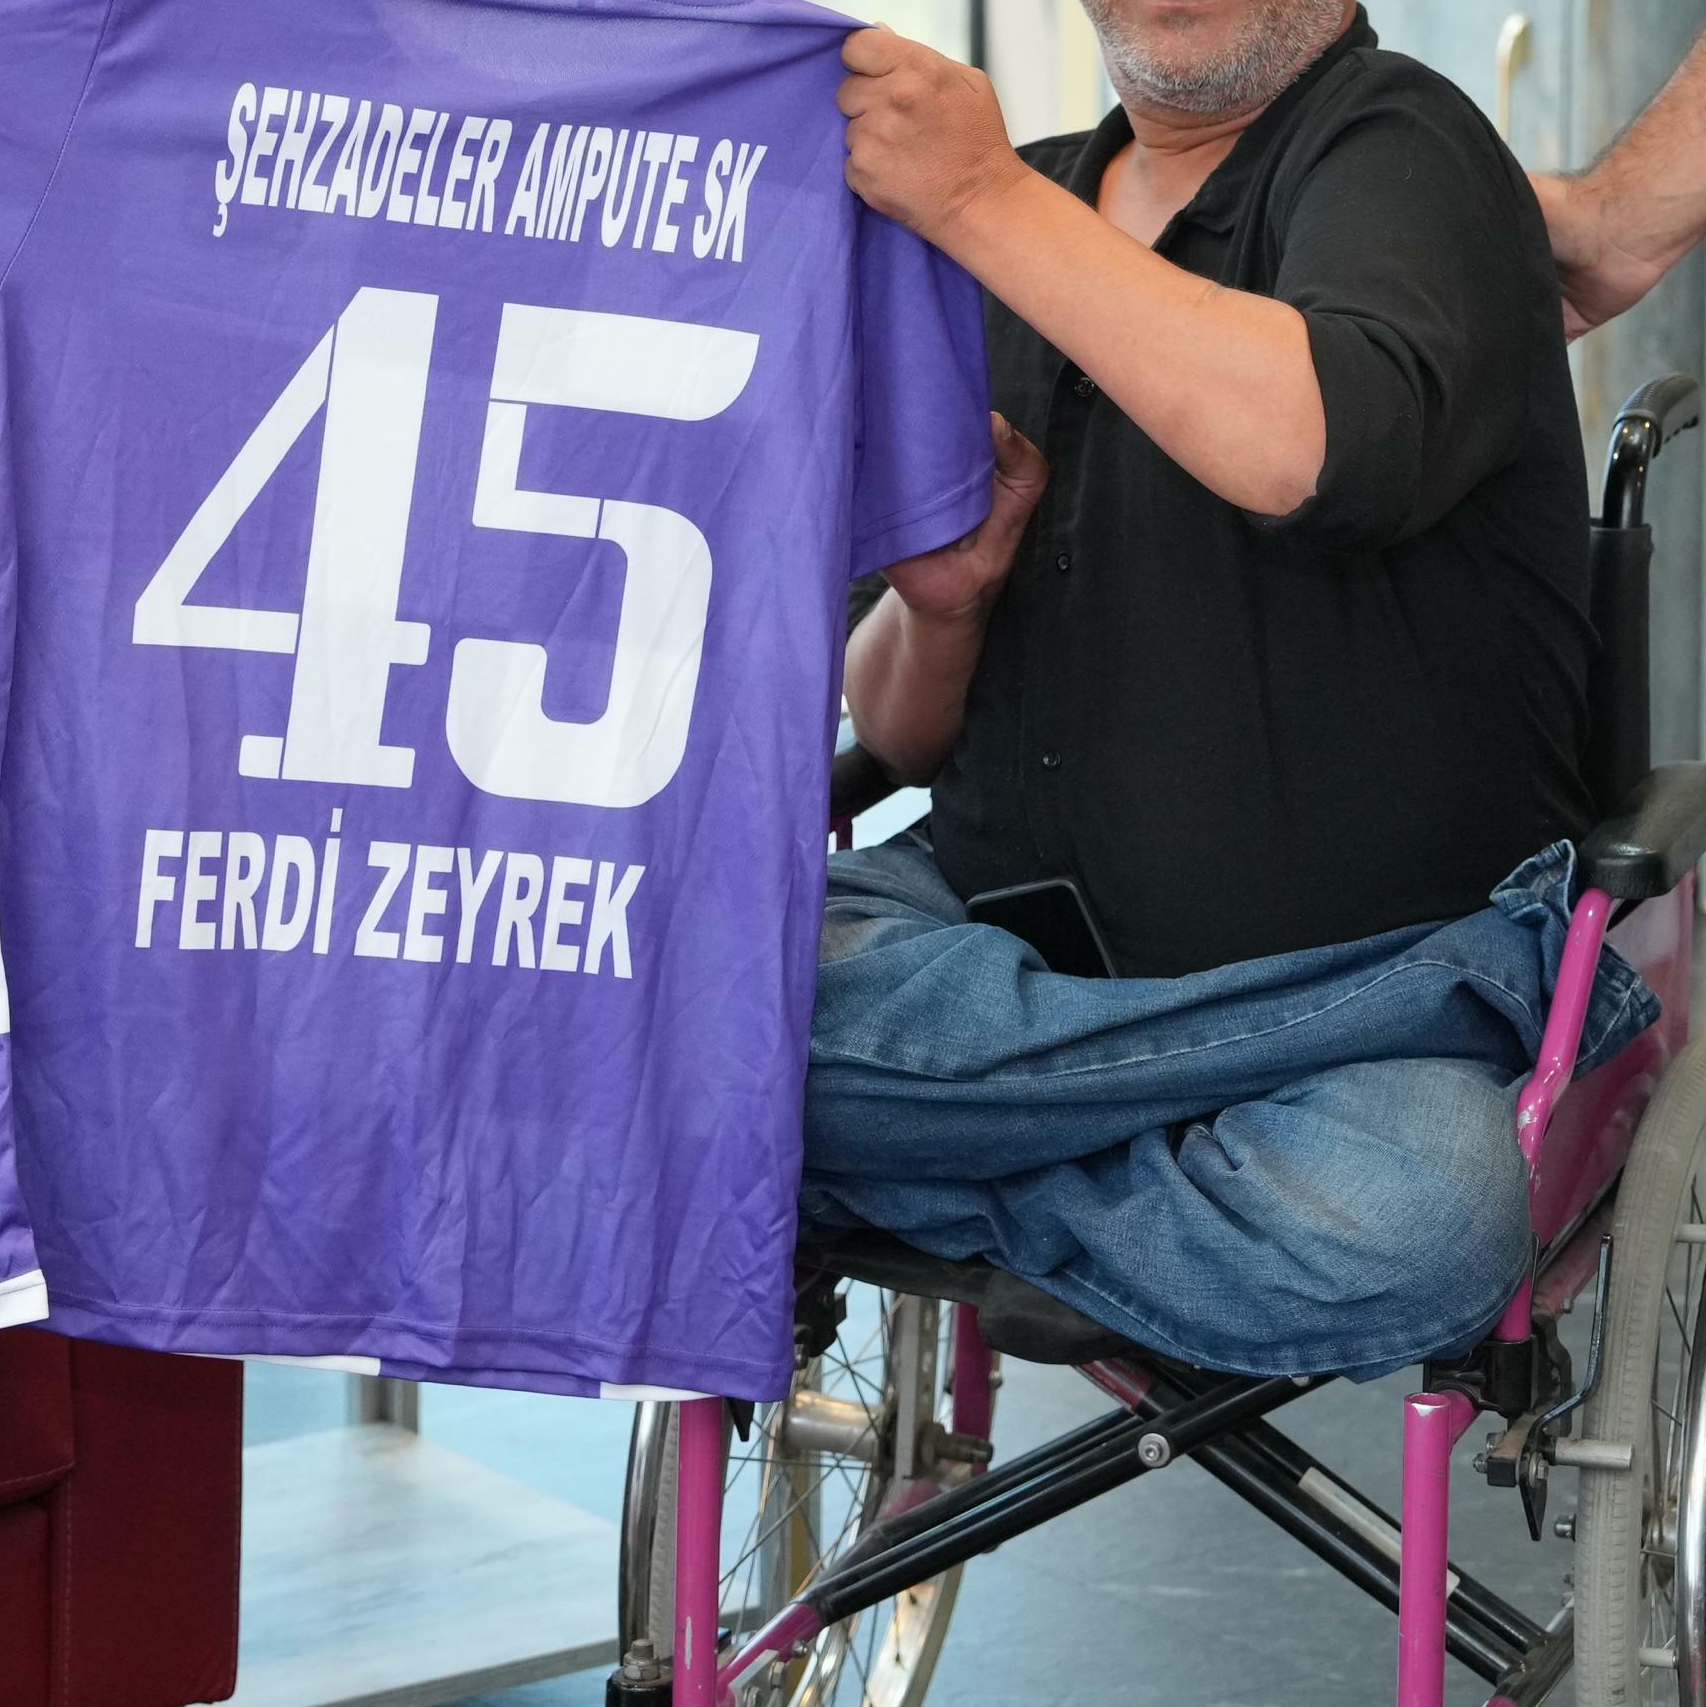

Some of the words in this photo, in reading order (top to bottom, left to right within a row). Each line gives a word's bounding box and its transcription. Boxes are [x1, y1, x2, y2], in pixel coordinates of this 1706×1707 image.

[212, 82, 513, 238] ŞEHZADELER
[503, 123, 699, 254] AMPUTE
[692, 138, 768, 263] SK
[131, 285, 760, 808] 45
[134, 807, 344, 955] FERDİ
[353, 840, 647, 980] ZEYREK
